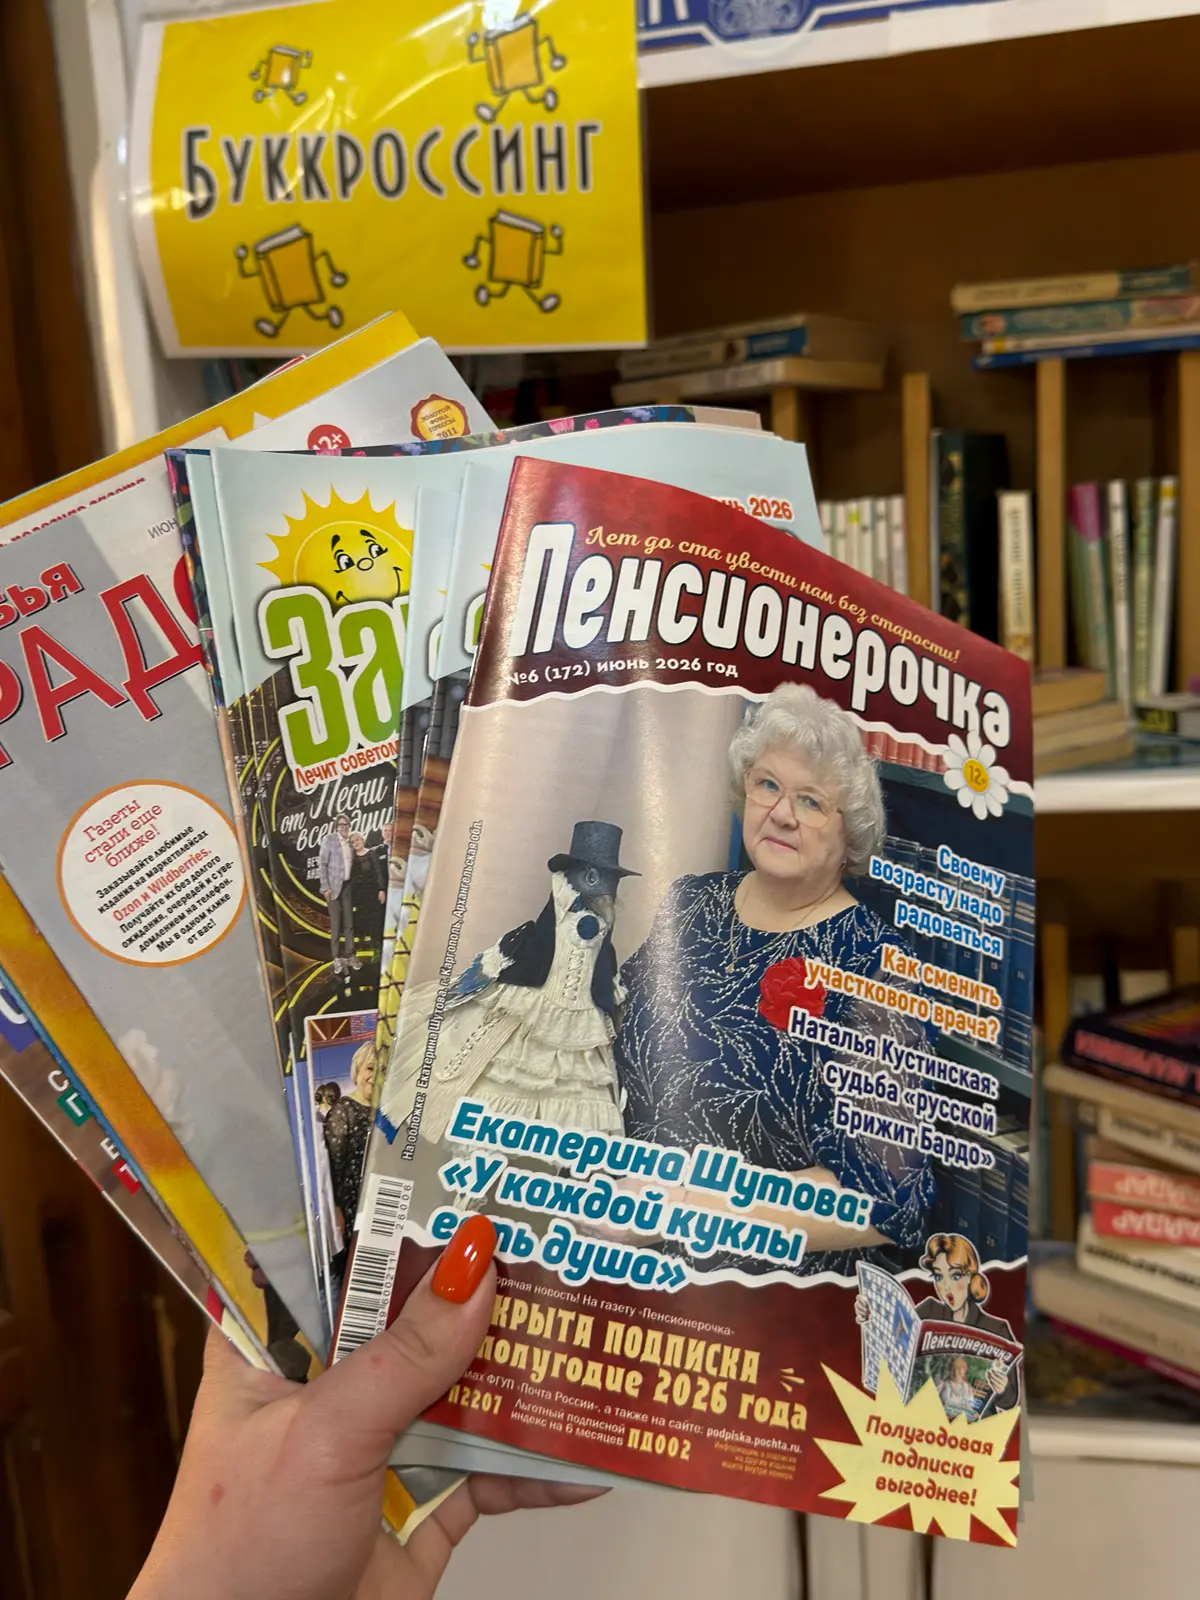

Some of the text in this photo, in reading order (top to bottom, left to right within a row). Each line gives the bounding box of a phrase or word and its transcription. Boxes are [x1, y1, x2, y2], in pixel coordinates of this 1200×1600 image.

[182, 121, 602, 221] БУККРОССИНГ
[436, 426, 459, 440] 2011
[147, 516, 179, 540] ИЮН
[748, 496, 793, 521] 2026
[584, 525, 961, 664] Лет до ста цвести нам без старости!
[507, 523, 1012, 748] Пенсионерочка
[264, 592, 409, 768] За
[503, 657, 739, 687] №6 (172) июнь 2026 год
[294, 760, 339, 789] Лечит
[309, 776, 389, 820] Песни
[83, 799, 141, 843] Газеты
[84, 804, 163, 863] стали еще
[105, 823, 160, 868] ближе!
[280, 811, 307, 835] от
[296, 817, 337, 852] все
[95, 825, 194, 900] Заказывайте любимые
[97, 829, 209, 915] издания на маркетплейсах
[112, 896, 142, 922] Ozon
[147, 846, 212, 895] Wildberries.
[871, 857, 1003, 926] возрасту надо
[938, 847, 1004, 894] Своему
[119, 855, 221, 934] Получайте их без долгого
[121, 913, 169, 949] ожидания,
[166, 882, 206, 914] очередей
[216, 860, 234, 879] уве-
[139, 879, 233, 953] домлением на телефон.
[156, 936, 175, 953] Мы
[180, 913, 207, 936] одном
[205, 892, 231, 915] клике
[187, 918, 217, 945] от вас!
[896, 901, 1001, 958] радоваться
[401, 819, 484, 1161] На обложке: Екатерина Шутова, г. Каргополь, Архангельская обл.
[805, 960, 999, 1042] участкового врача?
[882, 947, 1001, 1010] Как сменить
[791, 1010, 999, 1099] Наталья Кустинская:
[825, 1064, 996, 1133] судьба «русской
[449, 1101, 870, 1226] Екатерина Шутова:
[836, 1102, 993, 1168] Брижит Бардо»
[395, 1184, 412, 1230] 26006
[443, 1156, 804, 1261] «У каждой куклы
[431, 1211, 688, 1287] еть душа»
[381, 1254, 397, 1305] 600211
[496, 1276, 532, 1292] орячая
[534, 1284, 580, 1303] новость!
[582, 1294, 598, 1308] На
[600, 1300, 636, 1317] газету
[491, 1294, 761, 1385] КРЫТА ПОДПИСКА
[921, 1330, 1013, 1361] Пенсионерочка
[486, 1373, 515, 1390] ФГУП
[603, 1404, 611, 1415] а
[615, 1407, 649, 1423] также
[651, 1415, 667, 1427] на
[668, 1419, 704, 1434] сайте:
[706, 1426, 803, 1454] podpiska.pochta.ru.
[510, 1410, 625, 1446] индекс на 6 месяцев
[515, 1398, 626, 1434] Льготный подписной
[652, 1368, 729, 1415] 2026
[737, 1392, 808, 1431] года
[627, 1427, 692, 1461] ПД002
[865, 1414, 994, 1457] Полугодовая
[881, 1447, 975, 1480] подписка
[874, 1473, 978, 1508] выгоднее!
